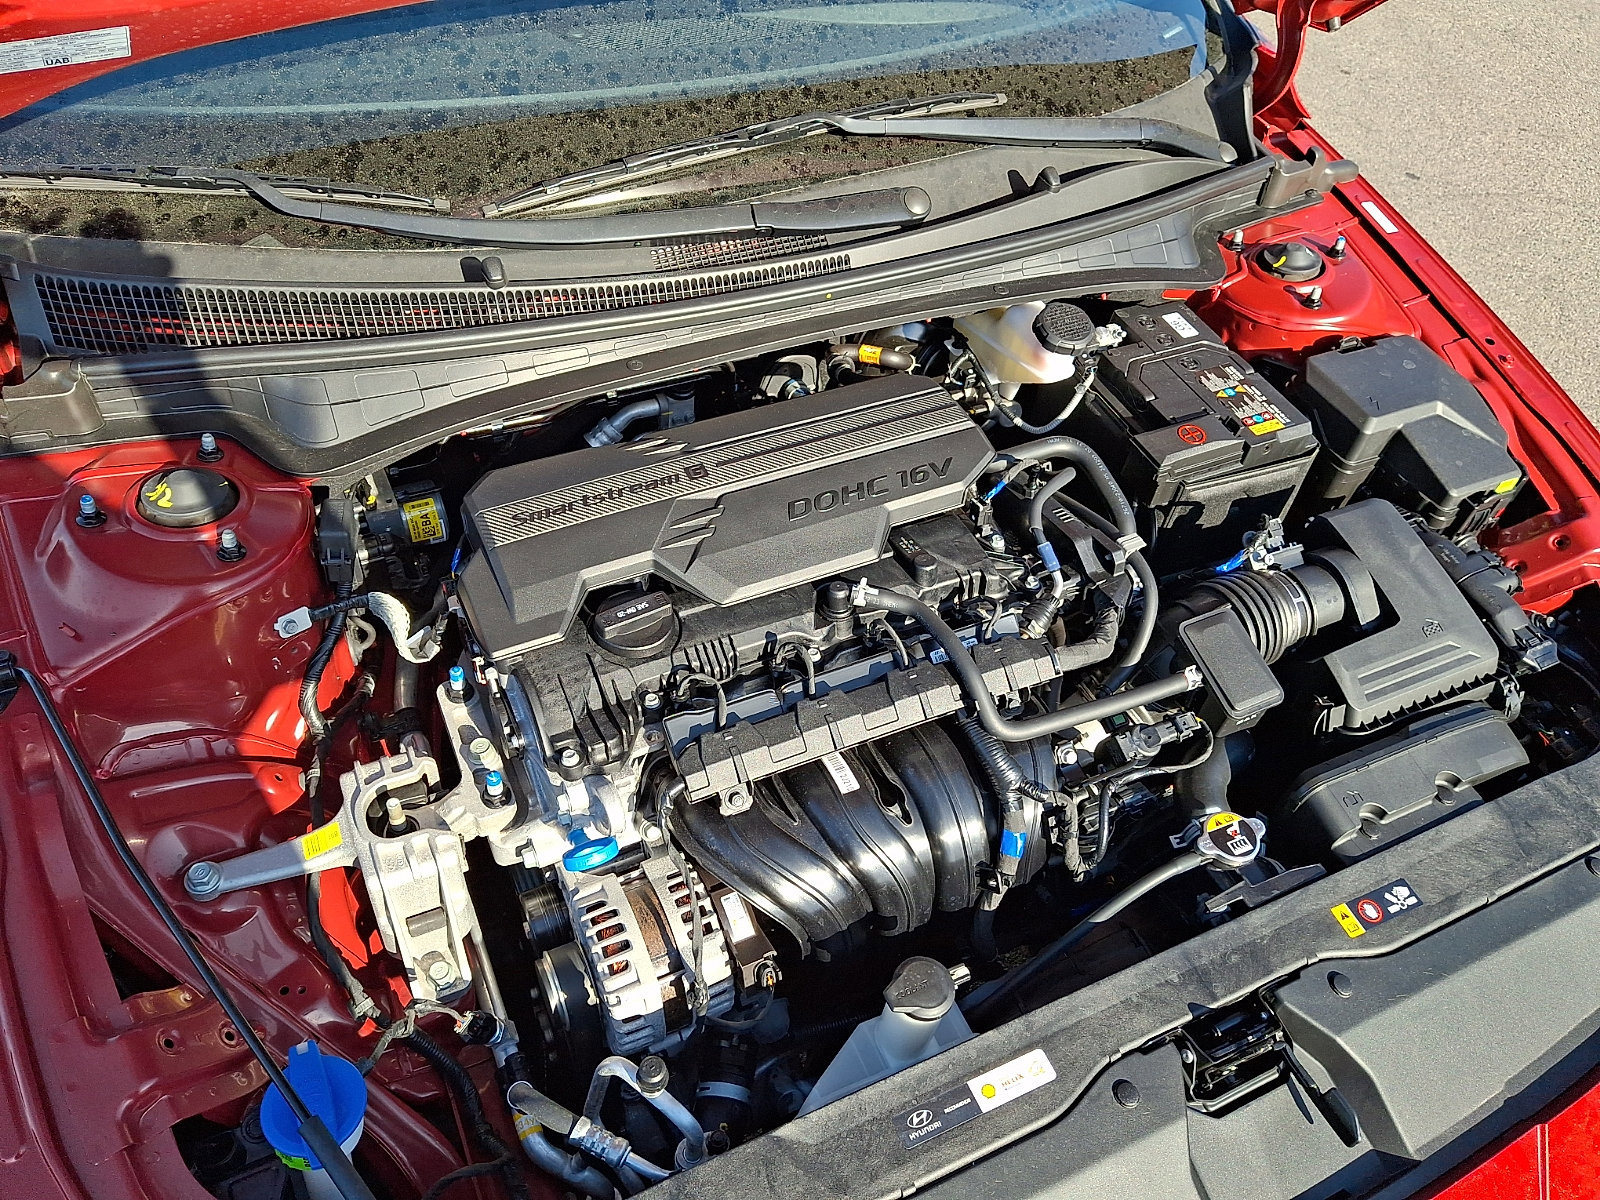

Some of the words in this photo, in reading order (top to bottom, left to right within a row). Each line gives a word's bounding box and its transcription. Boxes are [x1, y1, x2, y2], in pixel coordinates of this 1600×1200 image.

[45, 57, 70, 66] UAB
[510, 471, 680, 527] Smartstream
[787, 475, 890, 522] DOHC
[895, 456, 954, 489] 16V
[616, 606, 637, 618] 0W-20
[635, 601, 649, 613] SAE
[895, 979, 929, 1000] COOLANT
[908, 1120, 943, 1141] HYUNDAI
